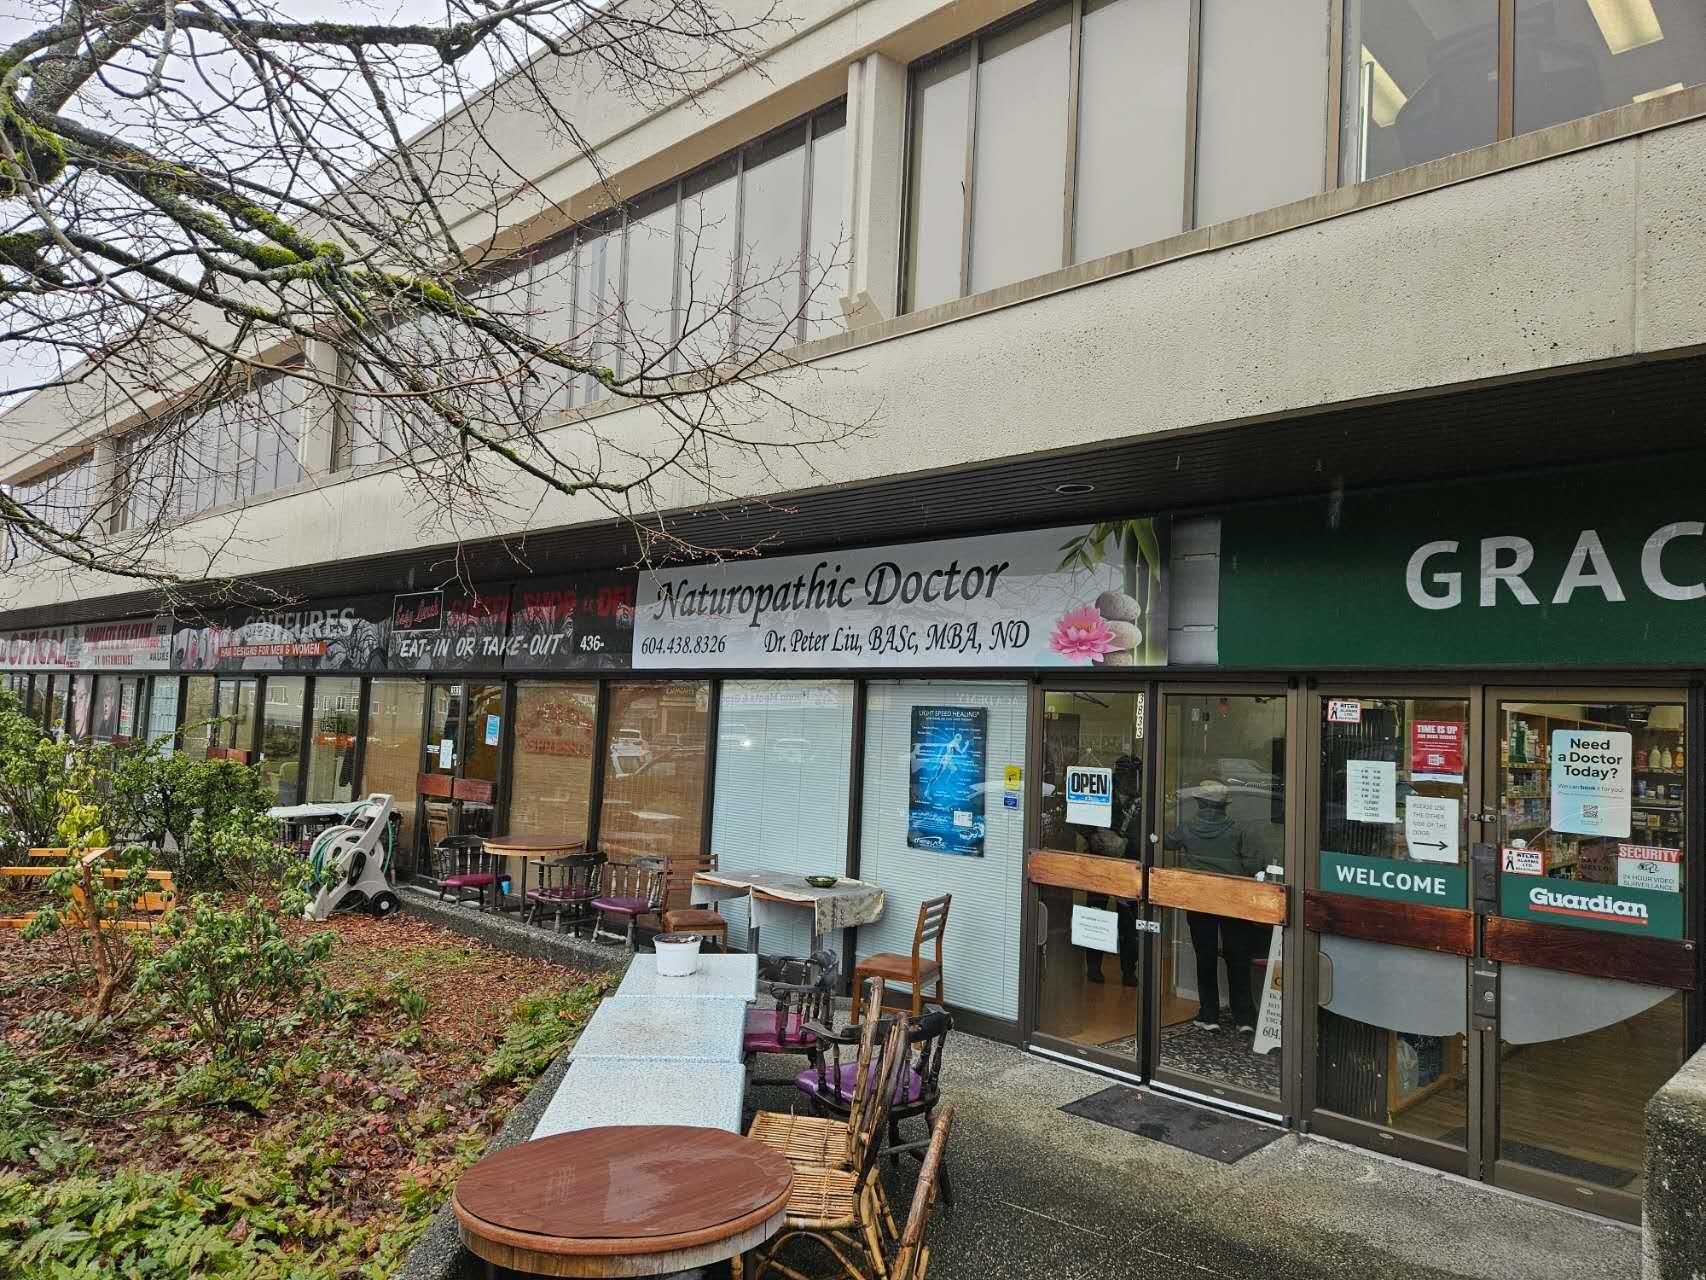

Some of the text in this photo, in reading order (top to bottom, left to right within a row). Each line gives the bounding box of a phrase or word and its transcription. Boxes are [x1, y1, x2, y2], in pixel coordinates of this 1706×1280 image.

[1406, 521, 1706, 610] GRAC
[653, 559, 1009, 627] Naturopathic Doctor
[259, 645, 270, 655] FOR
[271, 643, 284, 655] MEN
[292, 641, 320, 655] WOMEN
[400, 633, 566, 658] EAT-IN OR TAKE-OUT
[579, 635, 605, 652] 436-
[641, 634, 728, 655] 604.438.8326
[764, 620, 1030, 656] Dr. Peter Liu, BASc, MBA, ND
[1417, 725, 1457, 735] TIME IS UP
[1570, 738, 1610, 751] Need
[1558, 751, 1623, 765] a Doctor
[1071, 772, 1108, 795] OPEN
[1563, 765, 1618, 781] Today?
[1619, 846, 1679, 863] SECURITY
[1336, 864, 1447, 896] WELCOME
[1529, 886, 1649, 918] Guardian
